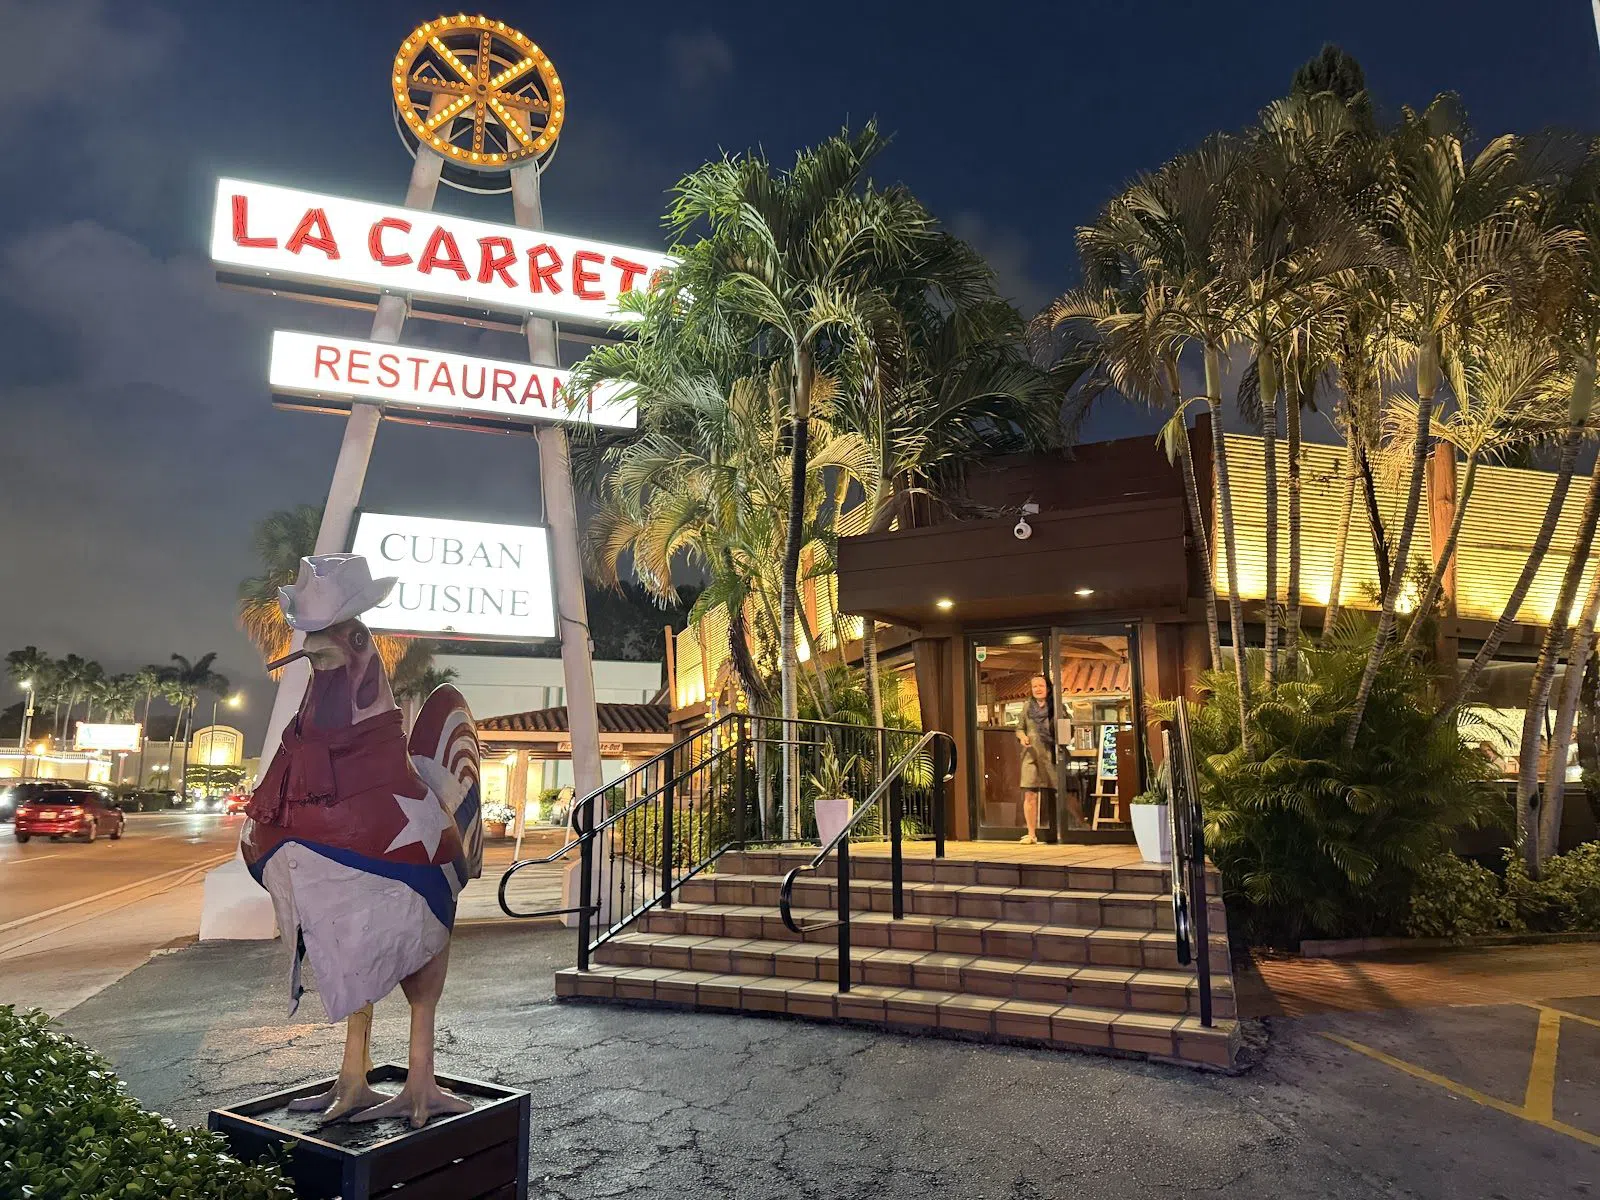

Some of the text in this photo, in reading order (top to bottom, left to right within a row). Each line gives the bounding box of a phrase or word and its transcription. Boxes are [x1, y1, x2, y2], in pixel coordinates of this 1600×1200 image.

[231, 194, 340, 260] LA
[380, 533, 523, 570] CUBAN
[600, 743, 621, 751] ke-Out
